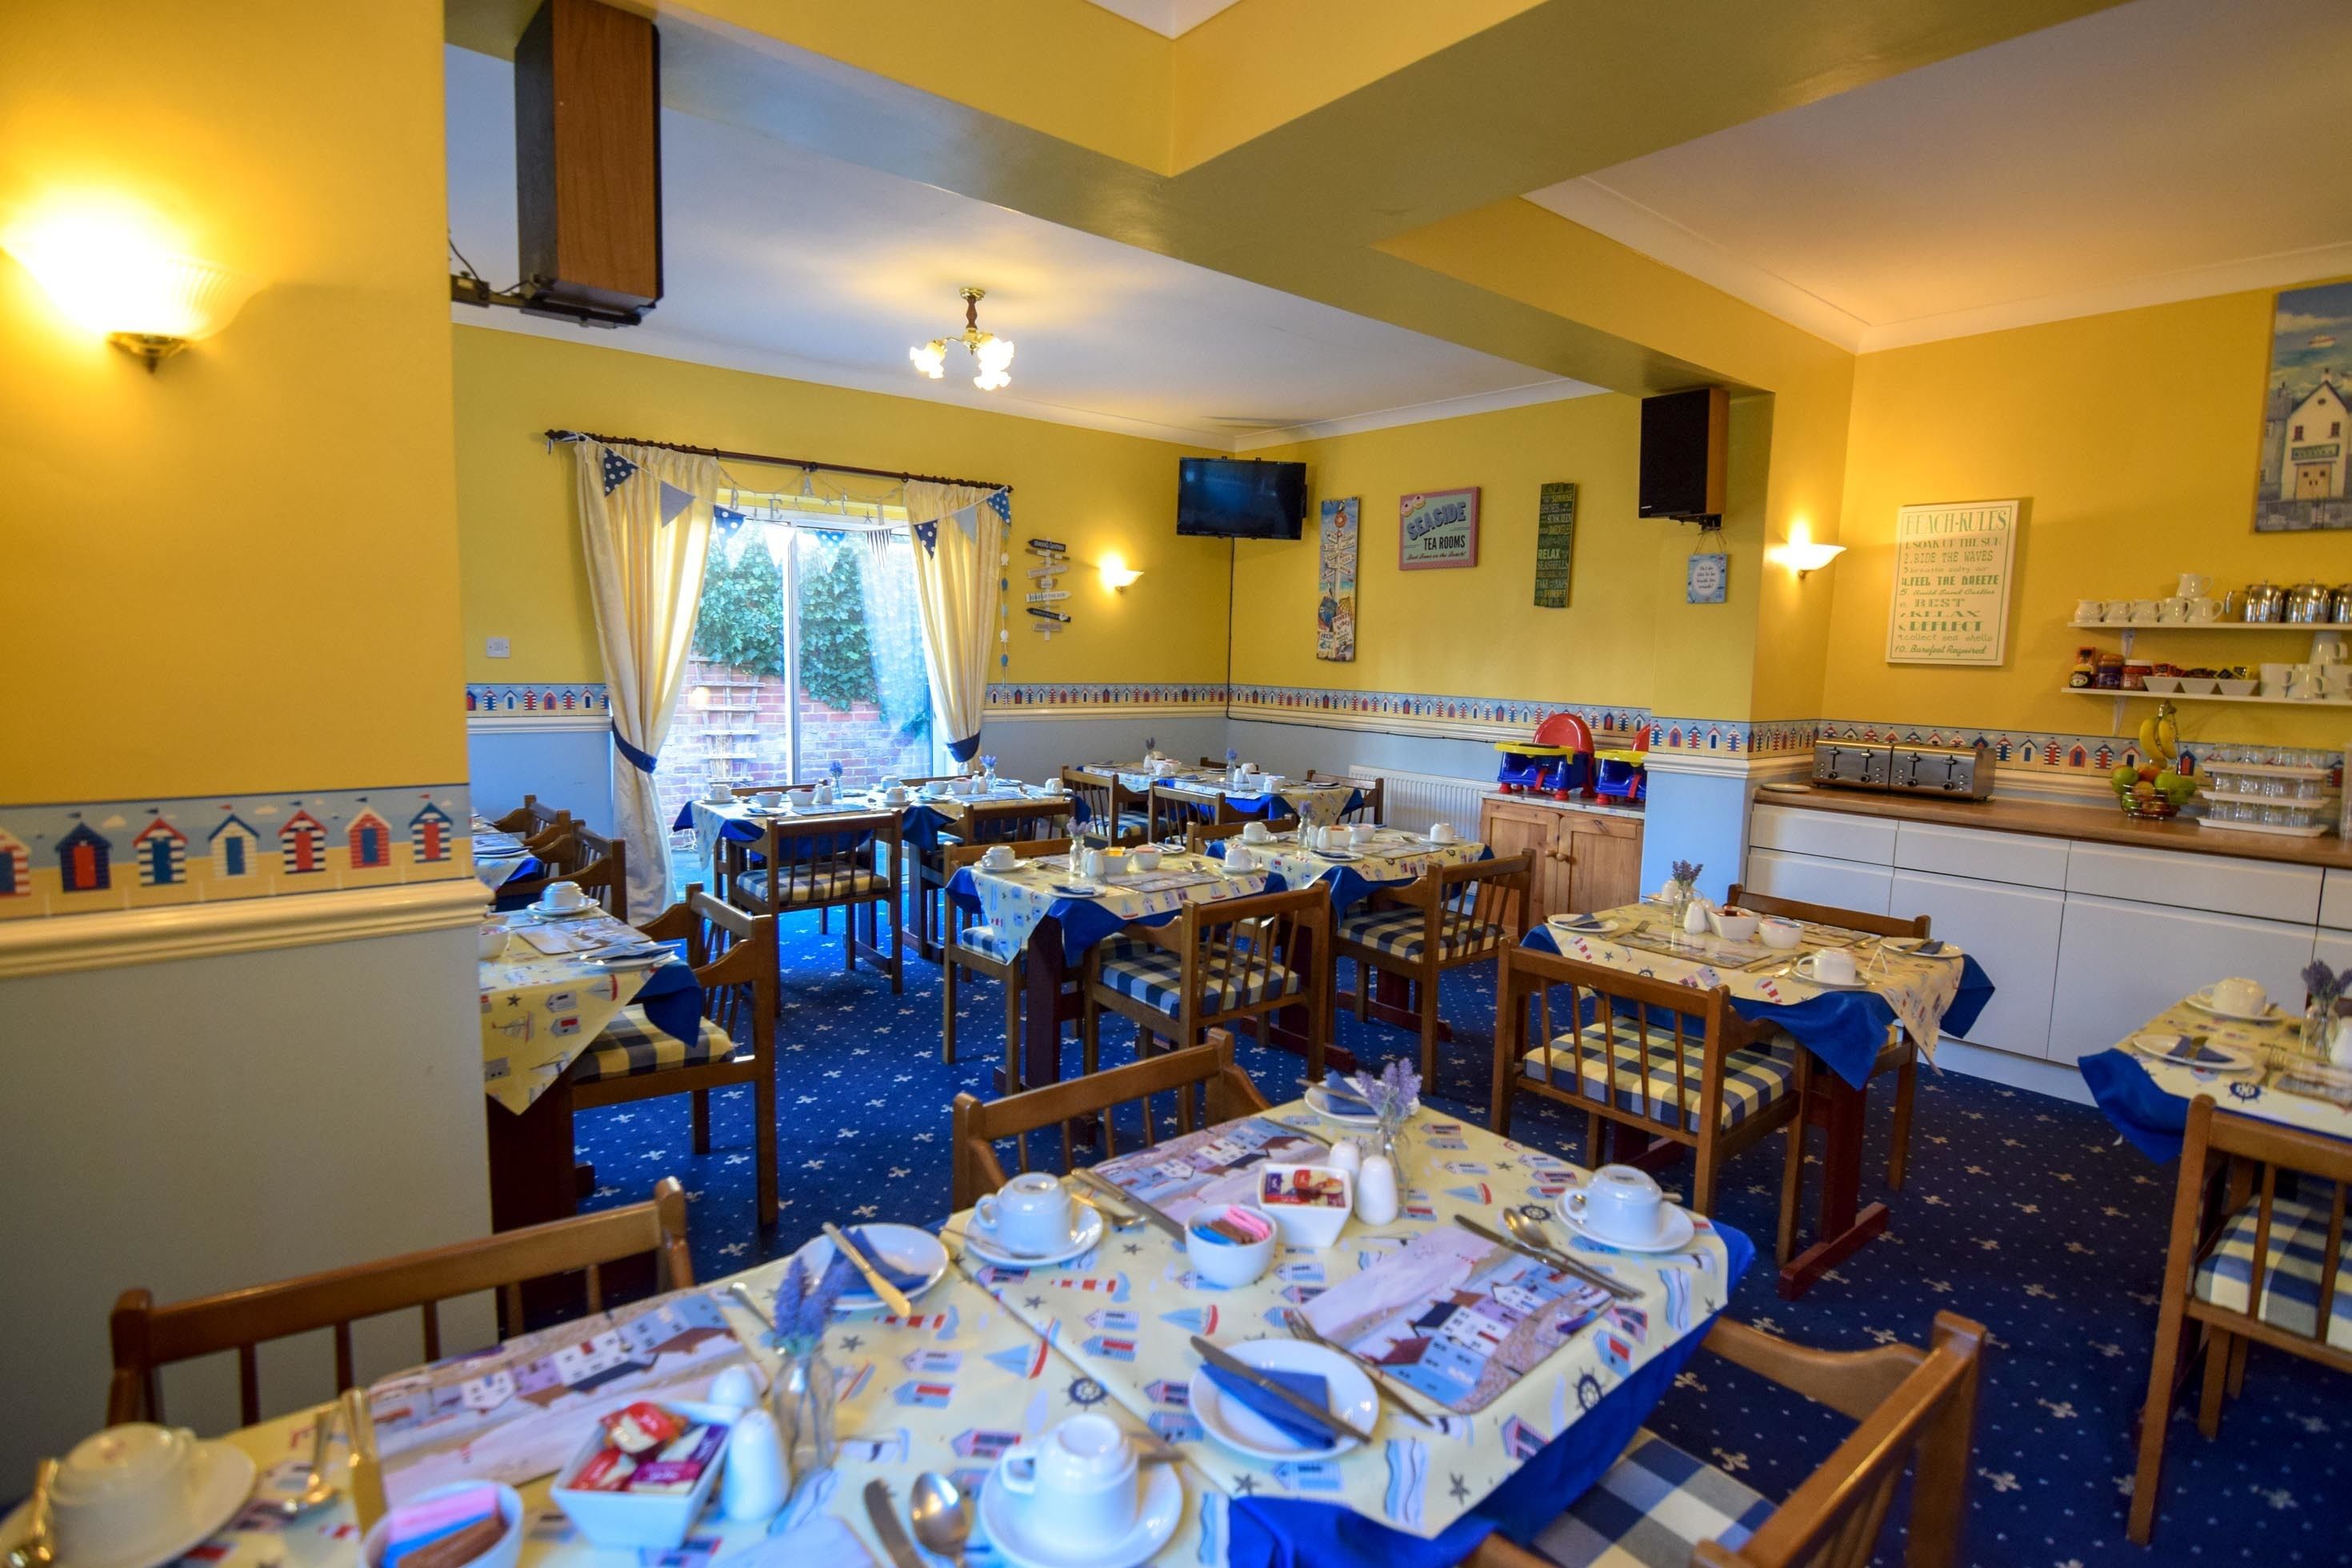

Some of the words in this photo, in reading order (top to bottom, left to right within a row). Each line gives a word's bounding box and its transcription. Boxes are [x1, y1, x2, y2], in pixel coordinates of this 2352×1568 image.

[1406, 501, 1466, 541] SEASIDE
[1424, 537, 1437, 550] TEA
[1439, 535, 1466, 550] ROOMS
[1913, 540, 1939, 550] SOAK
[1959, 538, 1978, 547] THE
[1538, 549, 1561, 559] RELAX
[1942, 552, 1959, 562] THE
[1965, 550, 1994, 562] WAVES
[1938, 575, 1956, 586] THE
[1962, 574, 2000, 585] BREEZE
[1914, 598, 1966, 608] REST
[1910, 621, 1984, 631] REFLECT
[1946, 644, 1988, 657] Required
